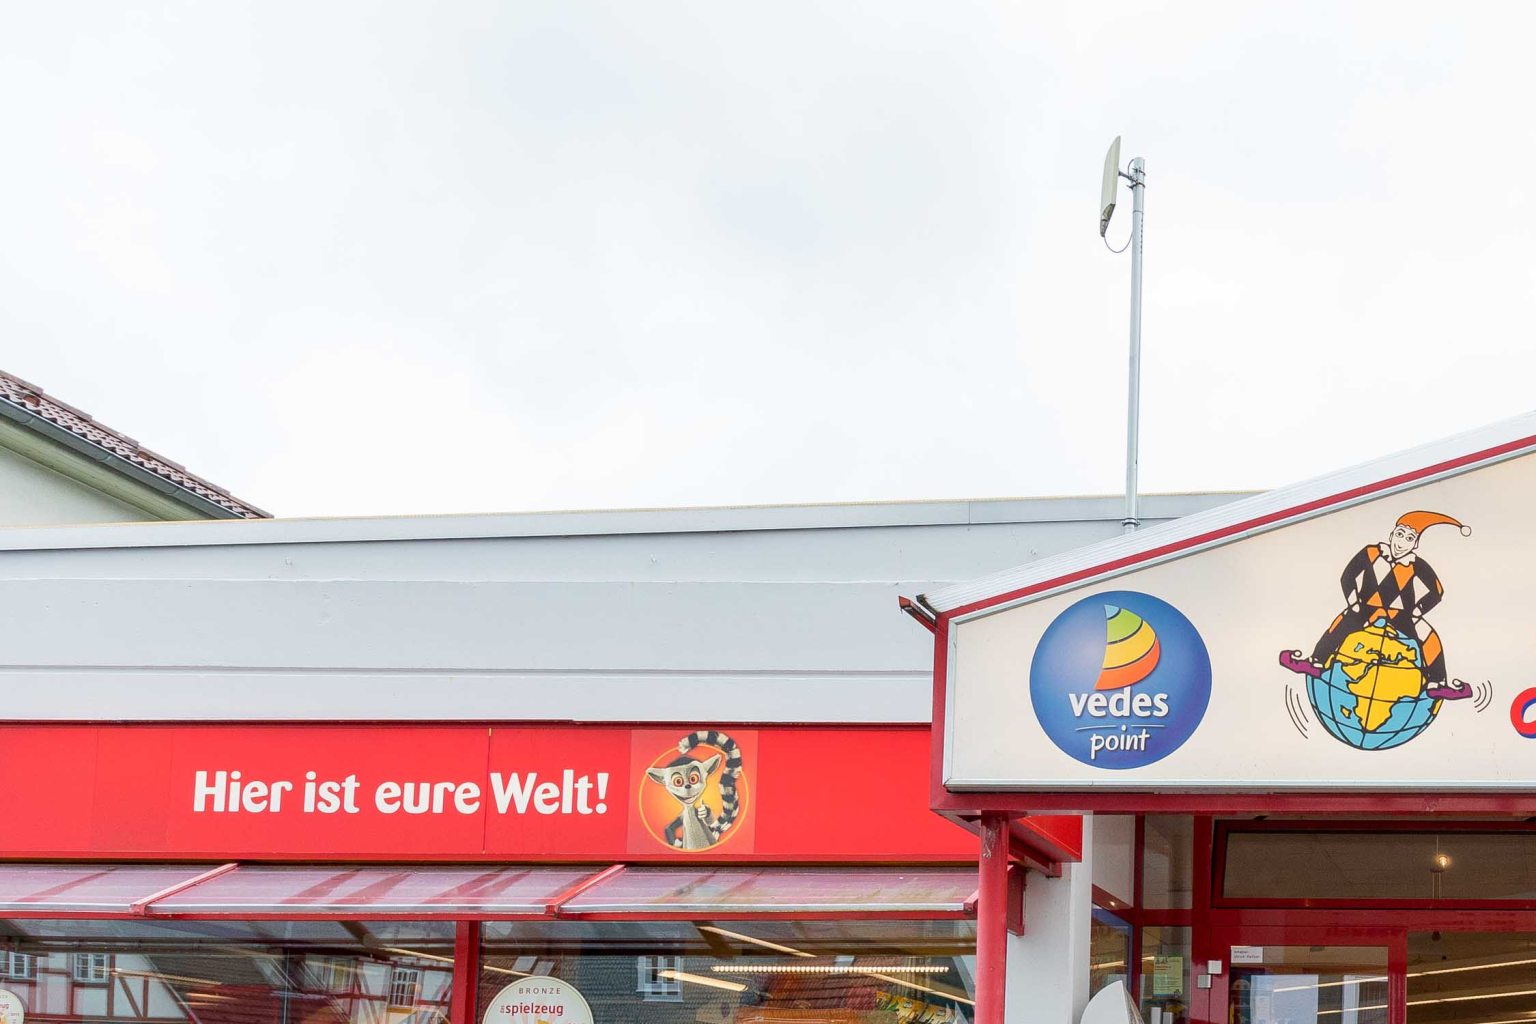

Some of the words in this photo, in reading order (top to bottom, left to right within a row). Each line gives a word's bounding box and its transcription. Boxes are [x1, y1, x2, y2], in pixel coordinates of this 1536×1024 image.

[1069, 686, 1170, 719] vedes
[1090, 725, 1151, 760] point
[193, 770, 292, 812] Hier
[303, 771, 360, 814] ist
[375, 781, 481, 815] eure
[489, 769, 609, 816] Welt!
[519, 987, 561, 995] BRONZE
[505, 1002, 564, 1016] spielzeug
